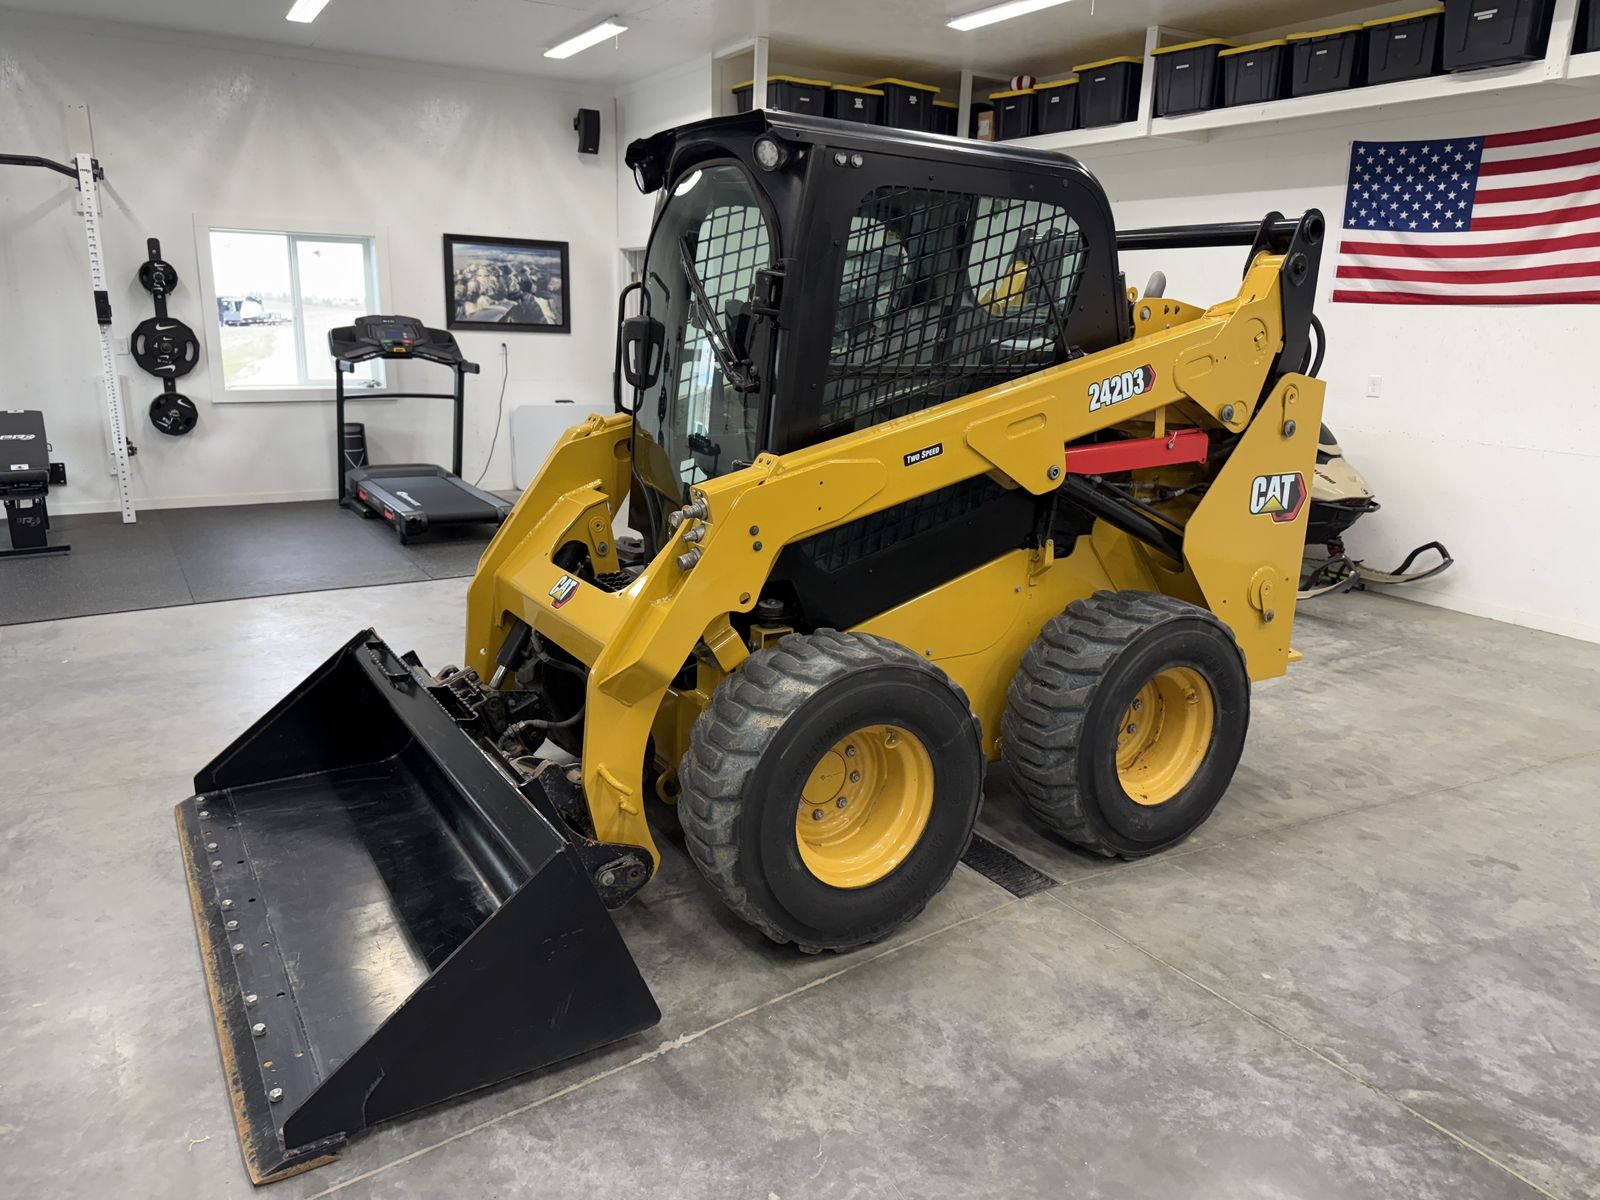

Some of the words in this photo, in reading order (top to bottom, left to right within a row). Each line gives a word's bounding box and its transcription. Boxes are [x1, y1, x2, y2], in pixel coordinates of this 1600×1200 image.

[1088, 367, 1145, 412] 242D3
[1250, 474, 1296, 514] CAT
[549, 575, 578, 601] CAT
